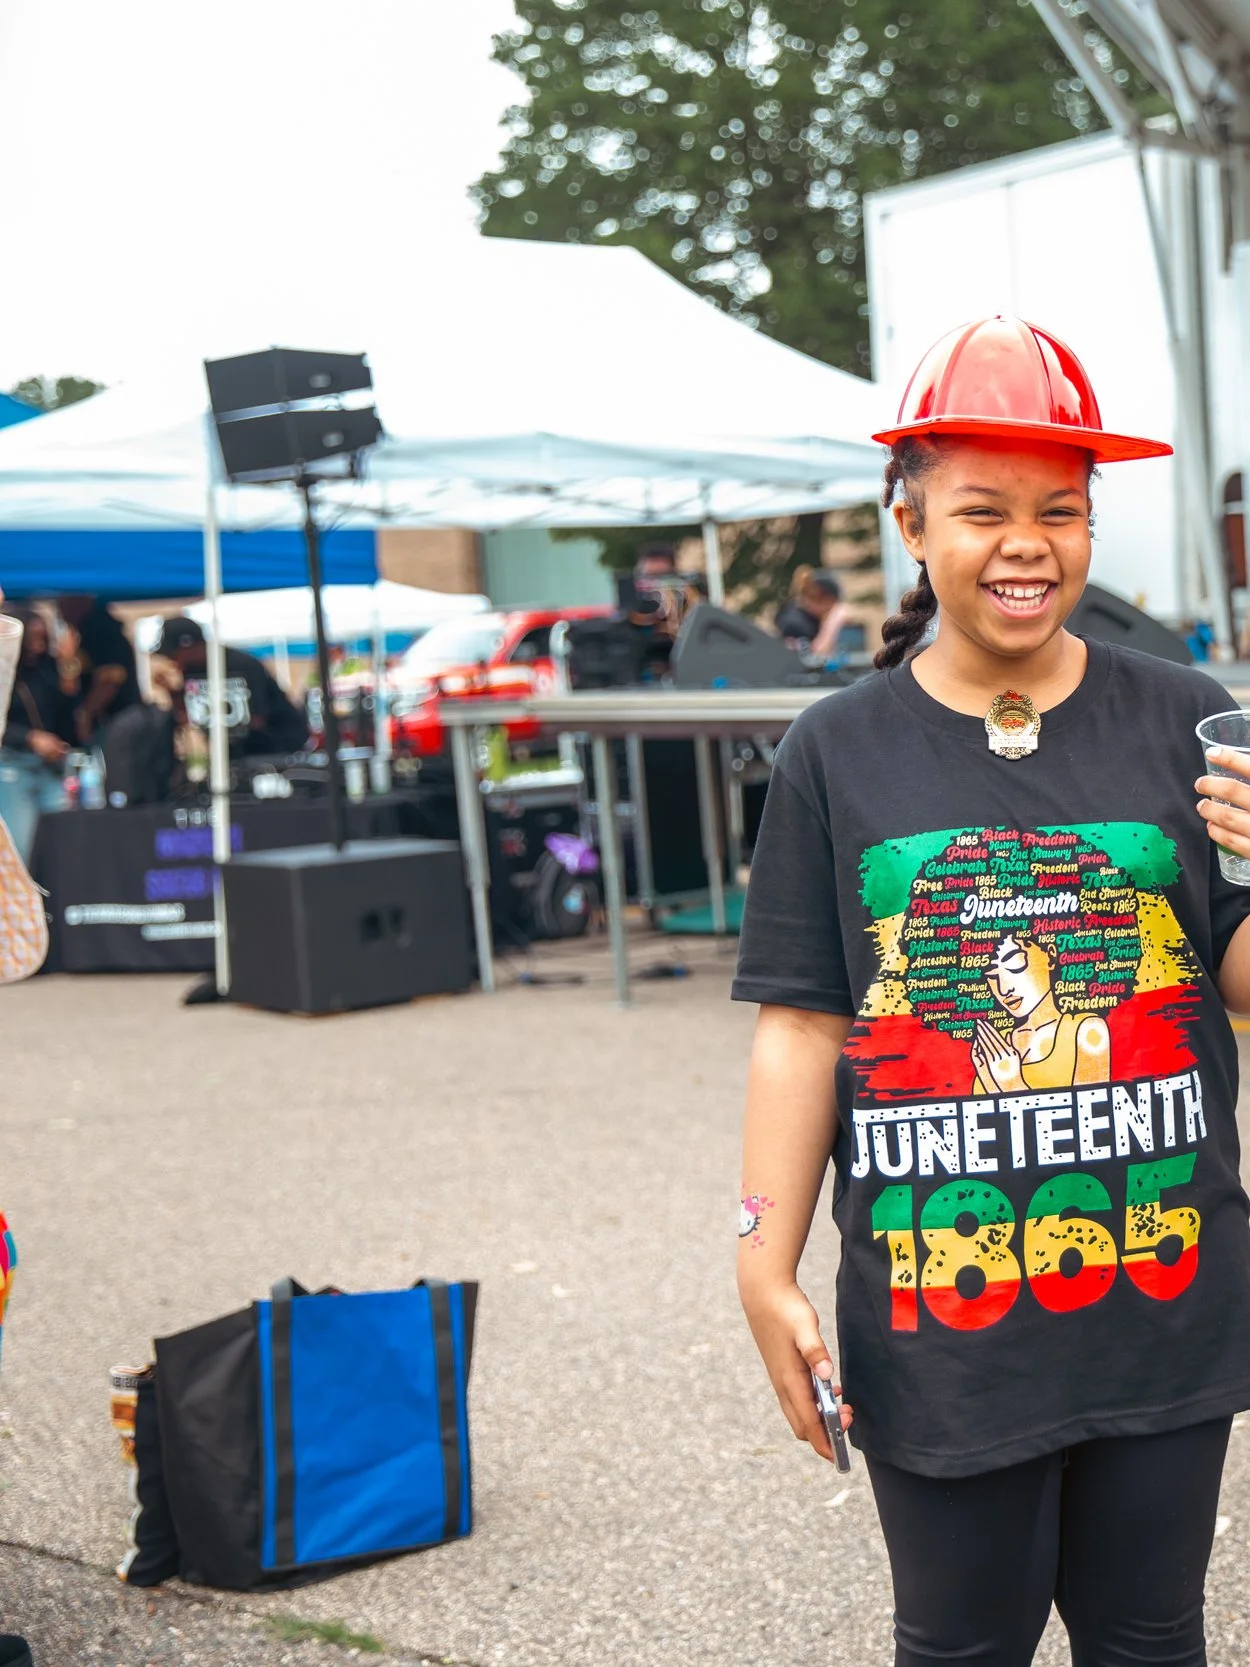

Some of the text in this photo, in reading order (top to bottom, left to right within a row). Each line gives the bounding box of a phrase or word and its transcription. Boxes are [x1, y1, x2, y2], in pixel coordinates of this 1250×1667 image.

[956, 835, 978, 846] 1865
[982, 829, 1019, 842] Black
[1022, 833, 1077, 848] Freedom
[947, 846, 988, 861] Pride
[1010, 848, 1028, 860] End
[1078, 854, 1108, 865] Pride
[925, 860, 987, 878] Celebrate
[990, 858, 1030, 874] Texas
[1030, 863, 1078, 876] Freedom
[1100, 867, 1118, 876] Black
[913, 879, 942, 894] Free
[945, 877, 974, 890] Pride
[975, 875, 997, 886] 1865
[997, 873, 1034, 888] Pride
[1038, 873, 1080, 888] Historic
[1082, 872, 1128, 890] Texas
[979, 887, 1012, 900] Black
[1079, 889, 1096, 900] End
[911, 899, 958, 918] Texas
[960, 891, 1080, 924] Juneteenth
[1081, 900, 1111, 914] Roots
[1113, 899, 1136, 914] 1865
[909, 917, 928, 928] 1865
[975, 920, 992, 931] End
[1033, 916, 1080, 934] Historic
[905, 928, 934, 940] Pride
[937, 926, 960, 937] 1865
[961, 930, 1000, 941] Freedom
[1038, 934, 1056, 944] 1865
[1056, 934, 1102, 952] Texas
[908, 939, 959, 957] Historic
[960, 941, 994, 956] Black
[1109, 946, 1142, 960] Pride
[911, 956, 956, 968] Ancestors
[961, 954, 990, 968] 1865
[1060, 951, 1104, 964] Celebrate
[948, 968, 982, 981] Black
[1061, 963, 1094, 980] 1865
[1098, 970, 1134, 983] Historic
[907, 978, 947, 991] Freedom
[1055, 980, 1086, 994] Black
[1089, 982, 1126, 998] Pride
[910, 988, 958, 1002] Celebrate
[918, 1001, 956, 1014] Freedom
[956, 997, 994, 1012] Texas
[1059, 996, 1118, 1014] Freedom
[988, 1010, 1006, 1019] Black
[994, 1018, 1014, 1028] 1865
[952, 1029, 972, 1038] 1865
[851, 1070, 1208, 1178] JUNETEENTH
[872, 1152, 1201, 1332] 1865
